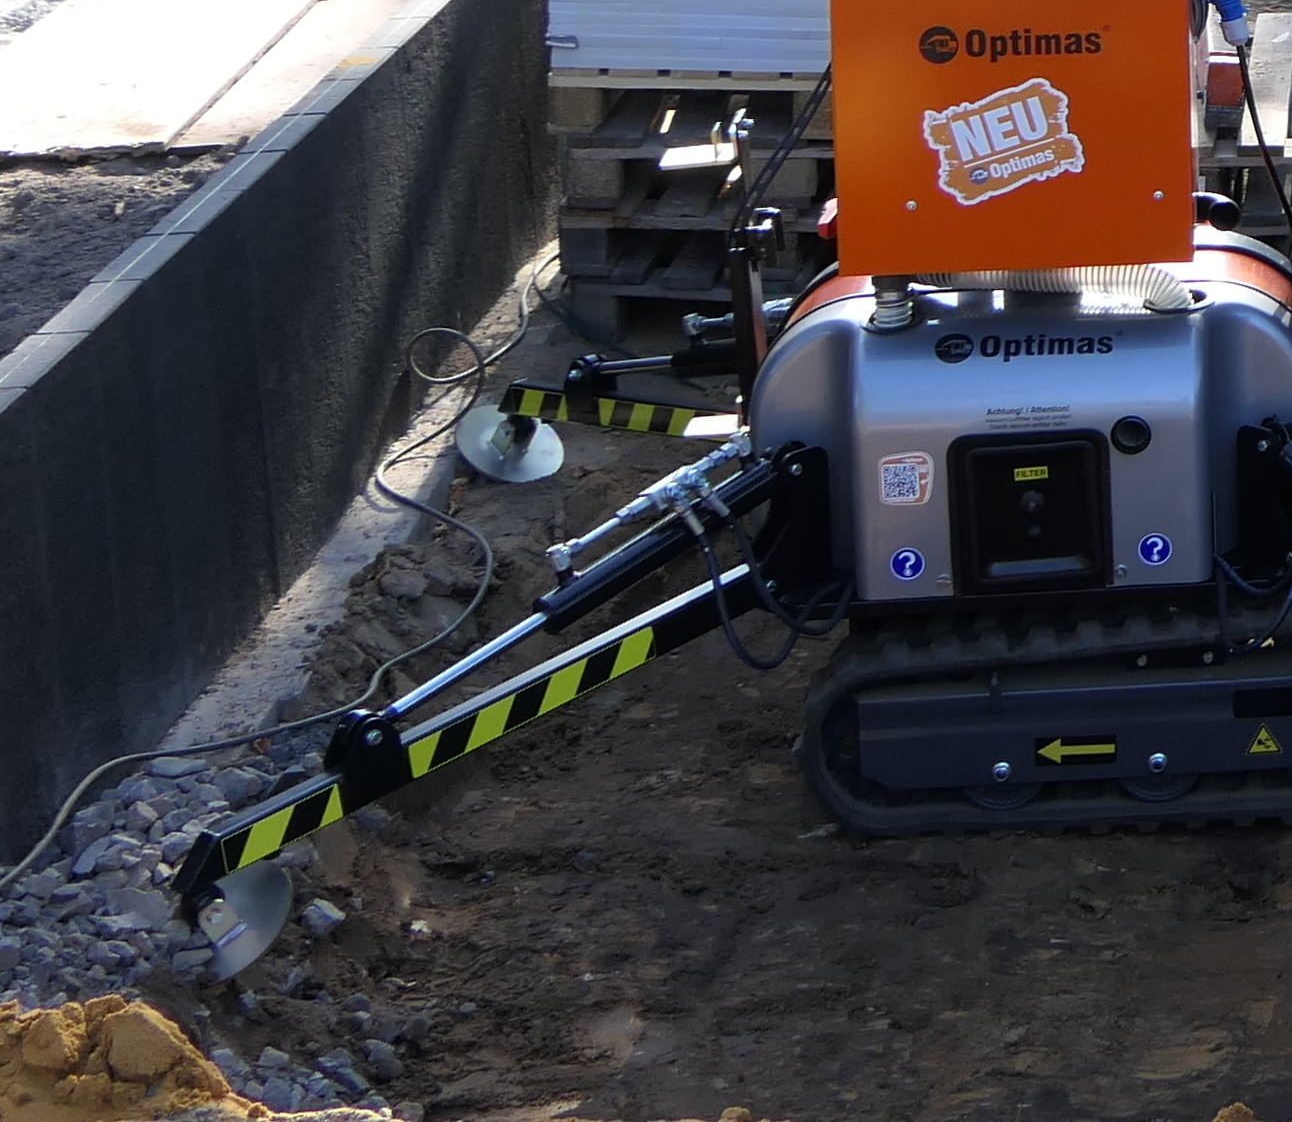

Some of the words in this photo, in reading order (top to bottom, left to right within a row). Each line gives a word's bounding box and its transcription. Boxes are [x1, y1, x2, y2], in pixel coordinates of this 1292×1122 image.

[965, 28, 1102, 63] Optimas
[950, 95, 1049, 163] NEU
[989, 149, 1056, 179] Optimas
[980, 334, 1114, 362] Optimas
[1016, 468, 1046, 478] FILTER
